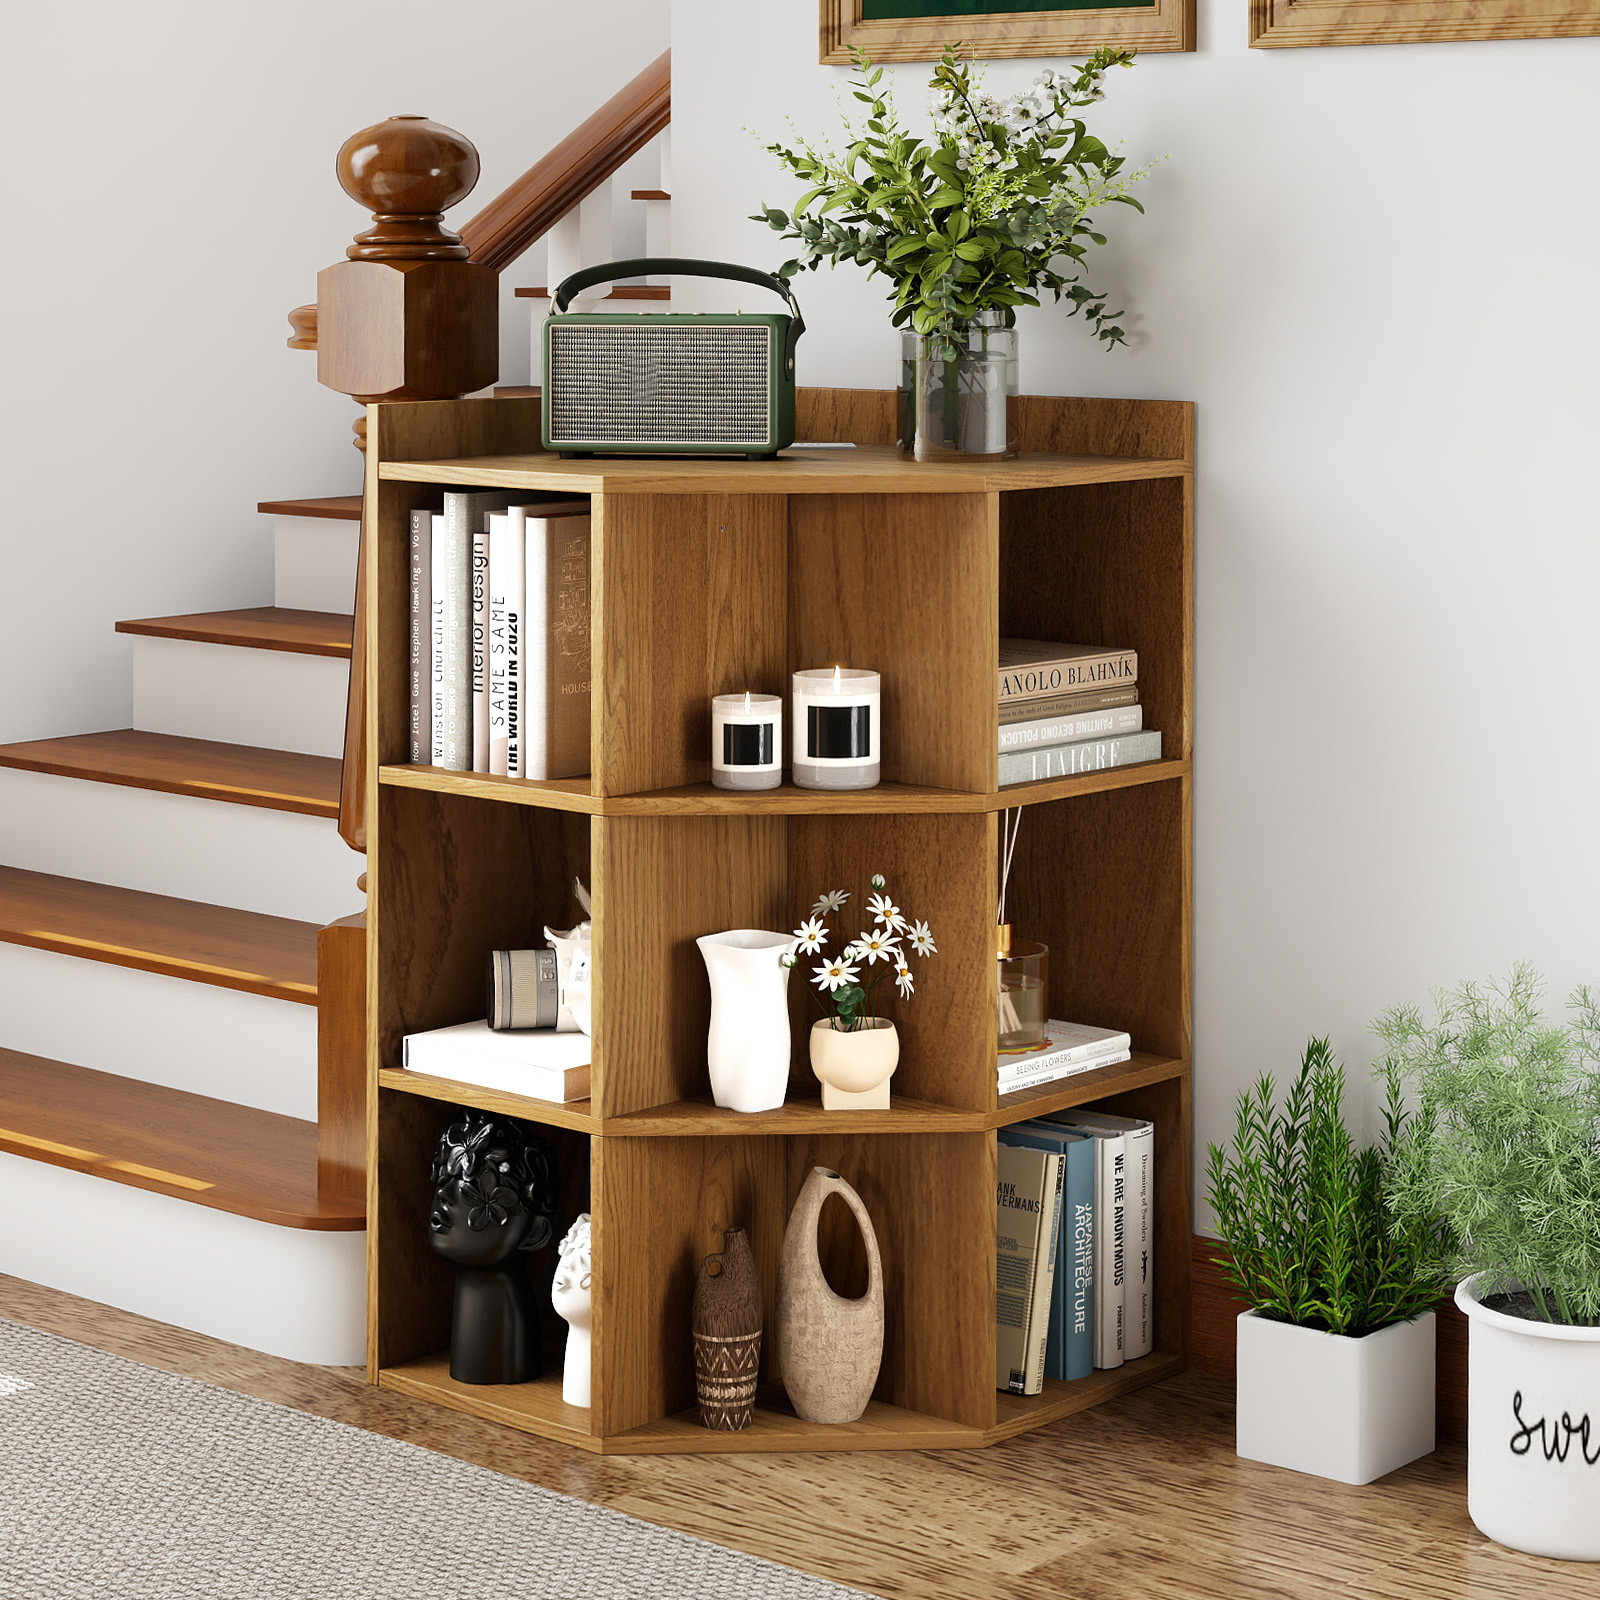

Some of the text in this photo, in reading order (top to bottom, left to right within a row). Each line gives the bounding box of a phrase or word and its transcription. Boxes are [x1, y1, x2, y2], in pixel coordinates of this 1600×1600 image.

[412, 568, 421, 613] Hawking
[473, 542, 488, 612] design
[412, 619, 421, 664] Stephen
[447, 499, 458, 761] How to make an arrangement in the house
[433, 599, 443, 757] Winston Churchill
[491, 596, 505, 726] SAME SAME
[1001, 657, 1133, 696] ANOLO BLAHNÍK
[509, 612, 518, 771] THE WORLD IN 2020
[1001, 716, 1113, 745] PAINTING BEYOND POLLOCK
[1017, 1053, 1072, 1075] SEEING FLOWERS
[1114, 1154, 1124, 1175] WE
[1140, 1154, 1148, 1195] Dreaming
[997, 1182, 1016, 1196] ANK
[997, 1195, 1044, 1214] VERMANS:
[1114, 1178, 1124, 1203] ARE
[1141, 1198, 1148, 1207] of
[1114, 1206, 1124, 1286] ANONYMOUS
[1075, 1204, 1085, 1334] ARCHITECTURE
[1510, 1390, 1600, 1464] Swe
